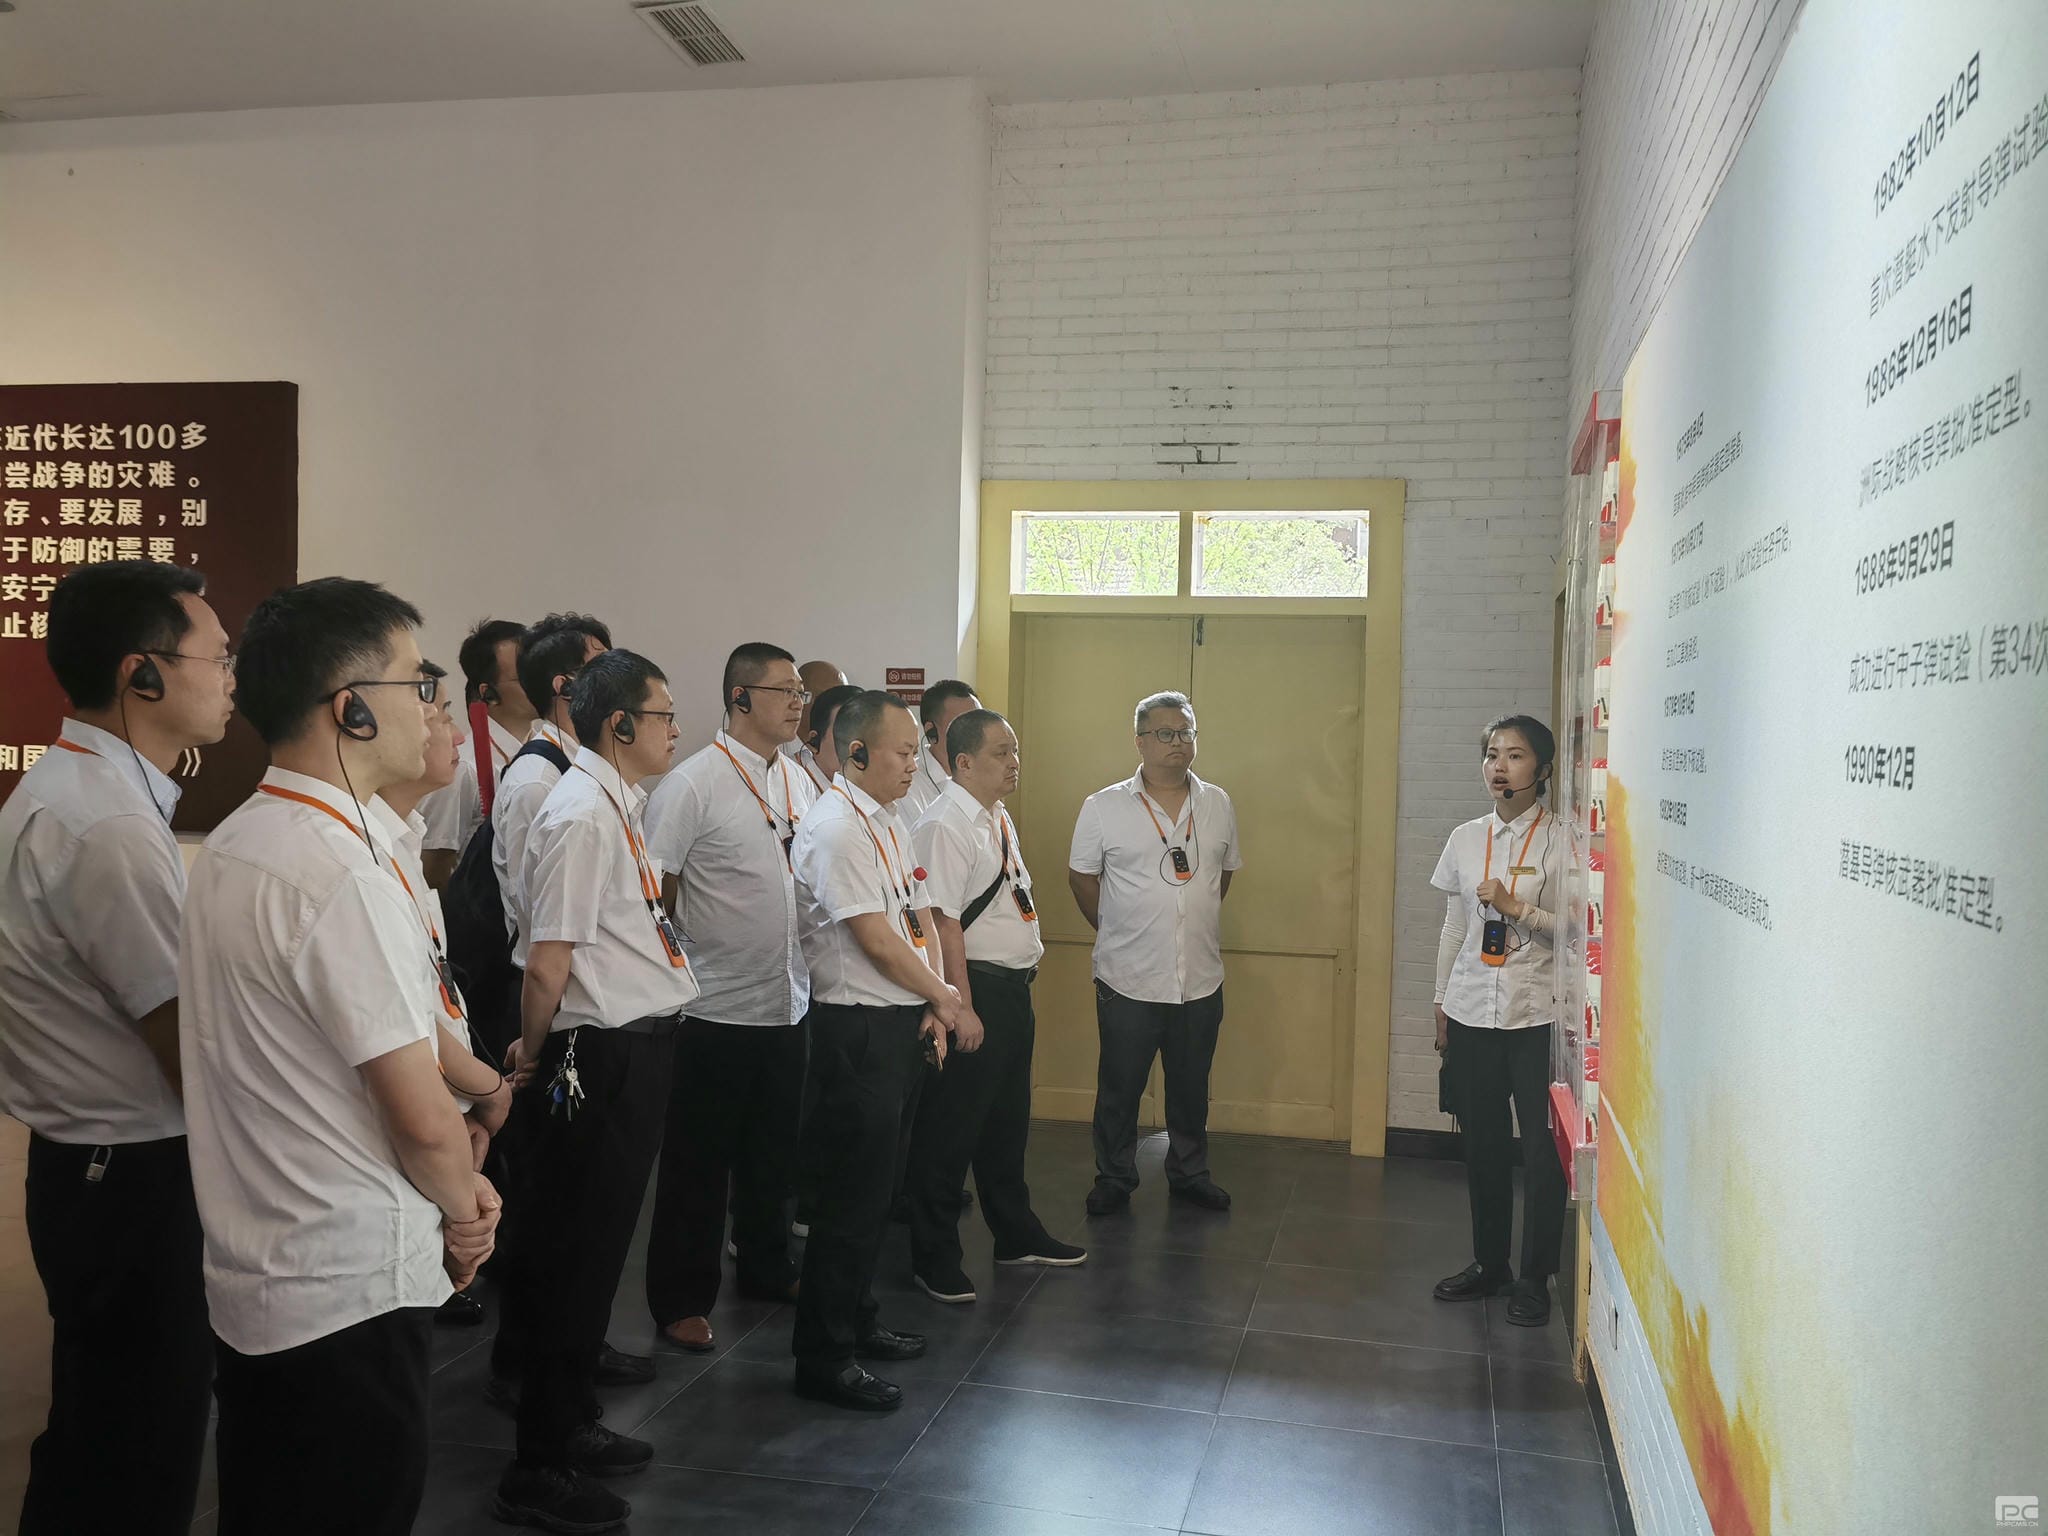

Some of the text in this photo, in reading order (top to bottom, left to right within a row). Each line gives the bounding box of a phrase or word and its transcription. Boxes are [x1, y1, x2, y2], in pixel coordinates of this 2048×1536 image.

[1874, 49, 1980, 219] 1982年10月12日
[1865, 283, 1973, 408] 1986年12月16日
[0, 422, 208, 451] 近代长达100多
[0, 460, 200, 489] 尝战争的灾难。
[2, 536, 199, 564] 于防御的需要，
[1855, 520, 1955, 596] 1988年9月29日
[1, 572, 60, 602] 安宁
[1844, 744, 1916, 791] 1990年12月
